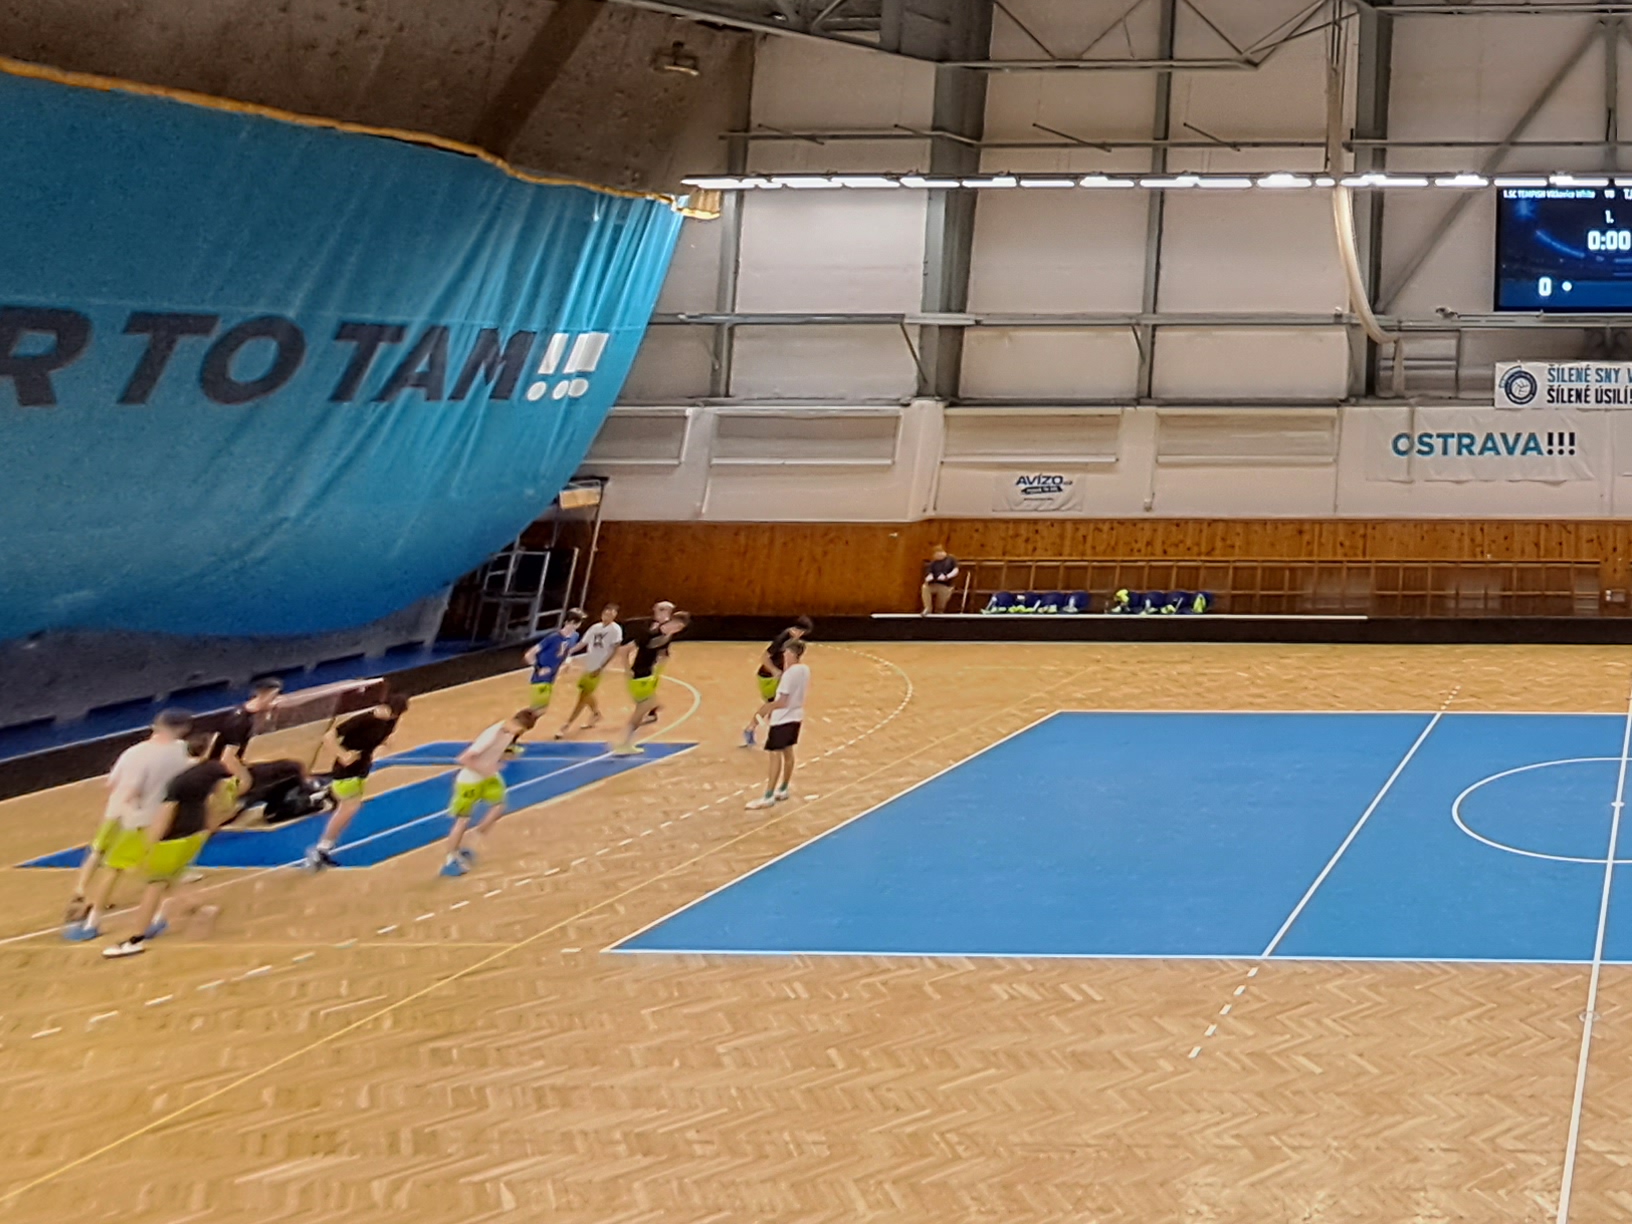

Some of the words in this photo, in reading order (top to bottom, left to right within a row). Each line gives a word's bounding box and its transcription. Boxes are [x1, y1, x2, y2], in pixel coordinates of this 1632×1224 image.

[1588, 230, 1631, 251] 0:00
[1538, 276, 1552, 297] 0
[116, 311, 306, 406] TO
[1595, 367, 1621, 383] SNY
[1547, 385, 1592, 404] ŠÍLENÉ
[1392, 431, 1575, 457] OSTRAVA!!!
